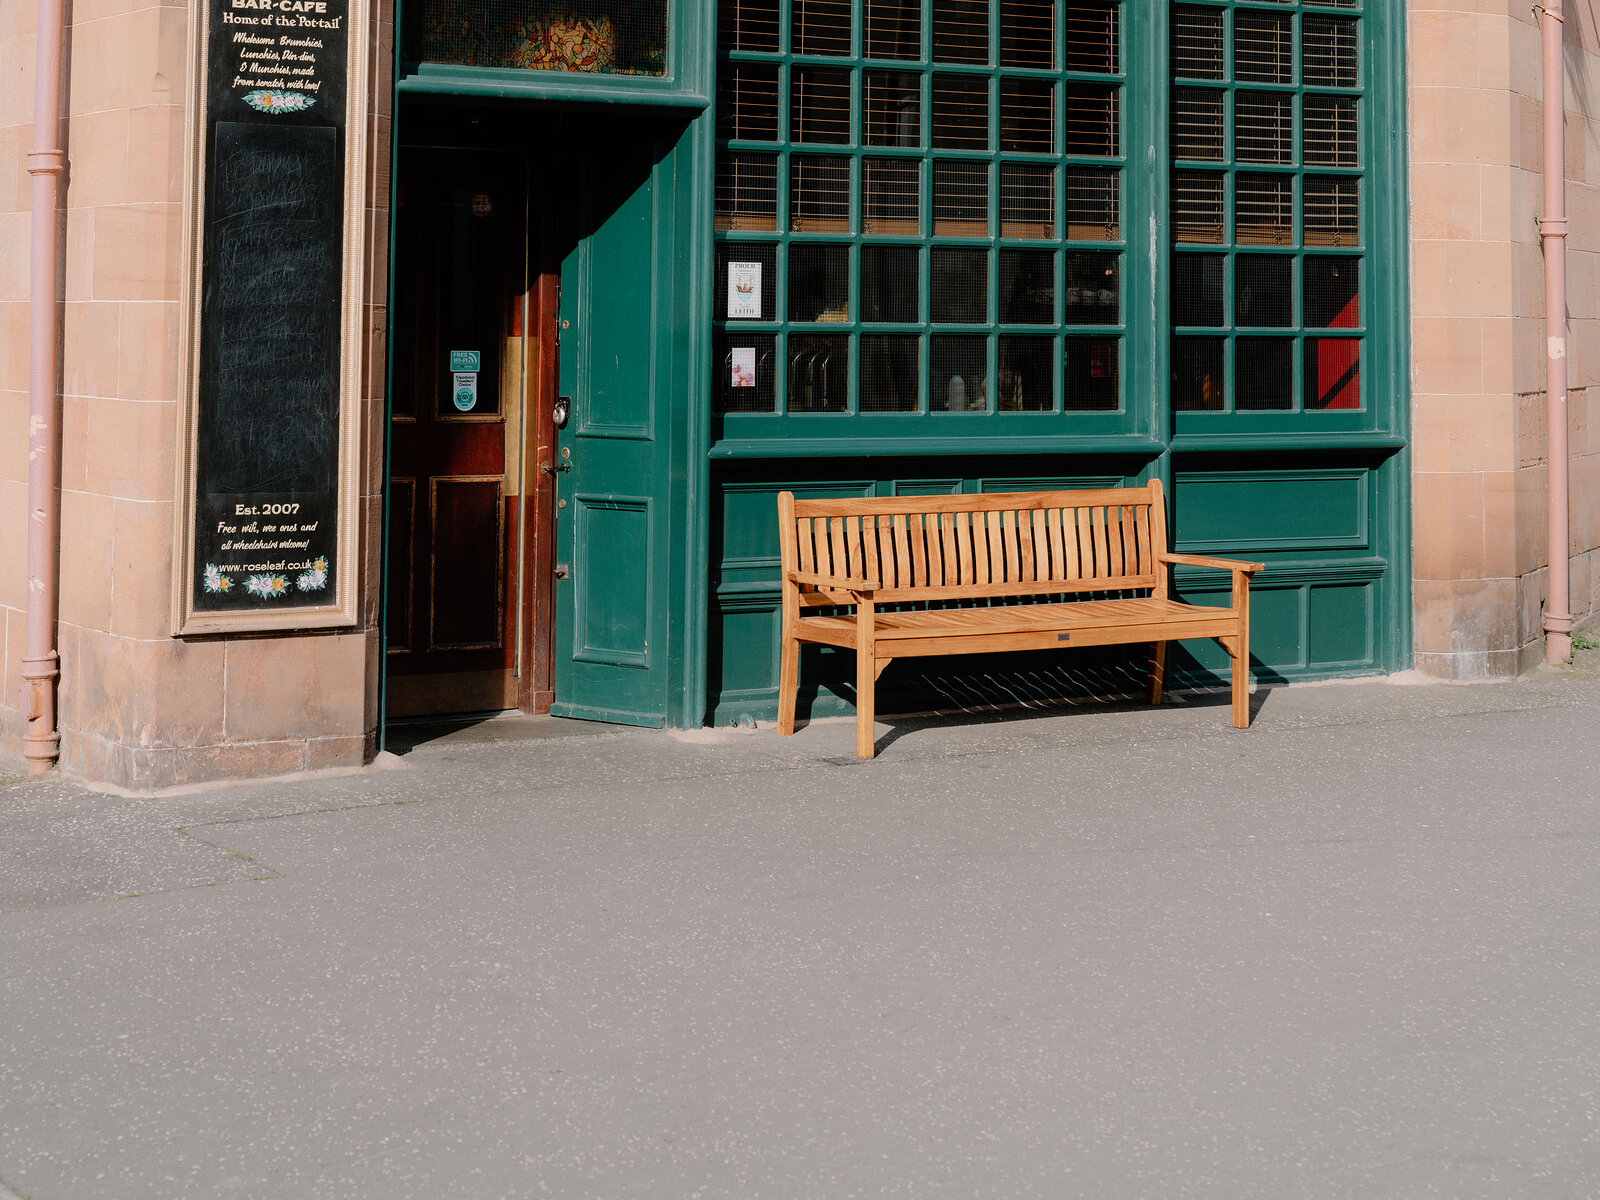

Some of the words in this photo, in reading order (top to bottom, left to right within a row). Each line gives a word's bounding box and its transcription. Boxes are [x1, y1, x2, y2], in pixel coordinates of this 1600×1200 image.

[222, 12, 259, 25] Home
[260, 14, 274, 26] of
[275, 16, 296, 27] the
[233, 31, 275, 46] Wholesome
[279, 36, 324, 49] Brunchies,
[292, 65, 314, 76] made
[232, 75, 255, 88] from
[286, 79, 303, 89] with
[235, 504, 260, 516] Est.
[262, 503, 300, 515] 2007
[217, 521, 237, 534] Free
[262, 523, 277, 533] wee
[279, 523, 297, 532] ones
[300, 521, 319, 532] and
[220, 540, 232, 550] all
[232, 540, 278, 550] wheelchairs
[218, 559, 313, 573] www.roseleaf.co.uk
